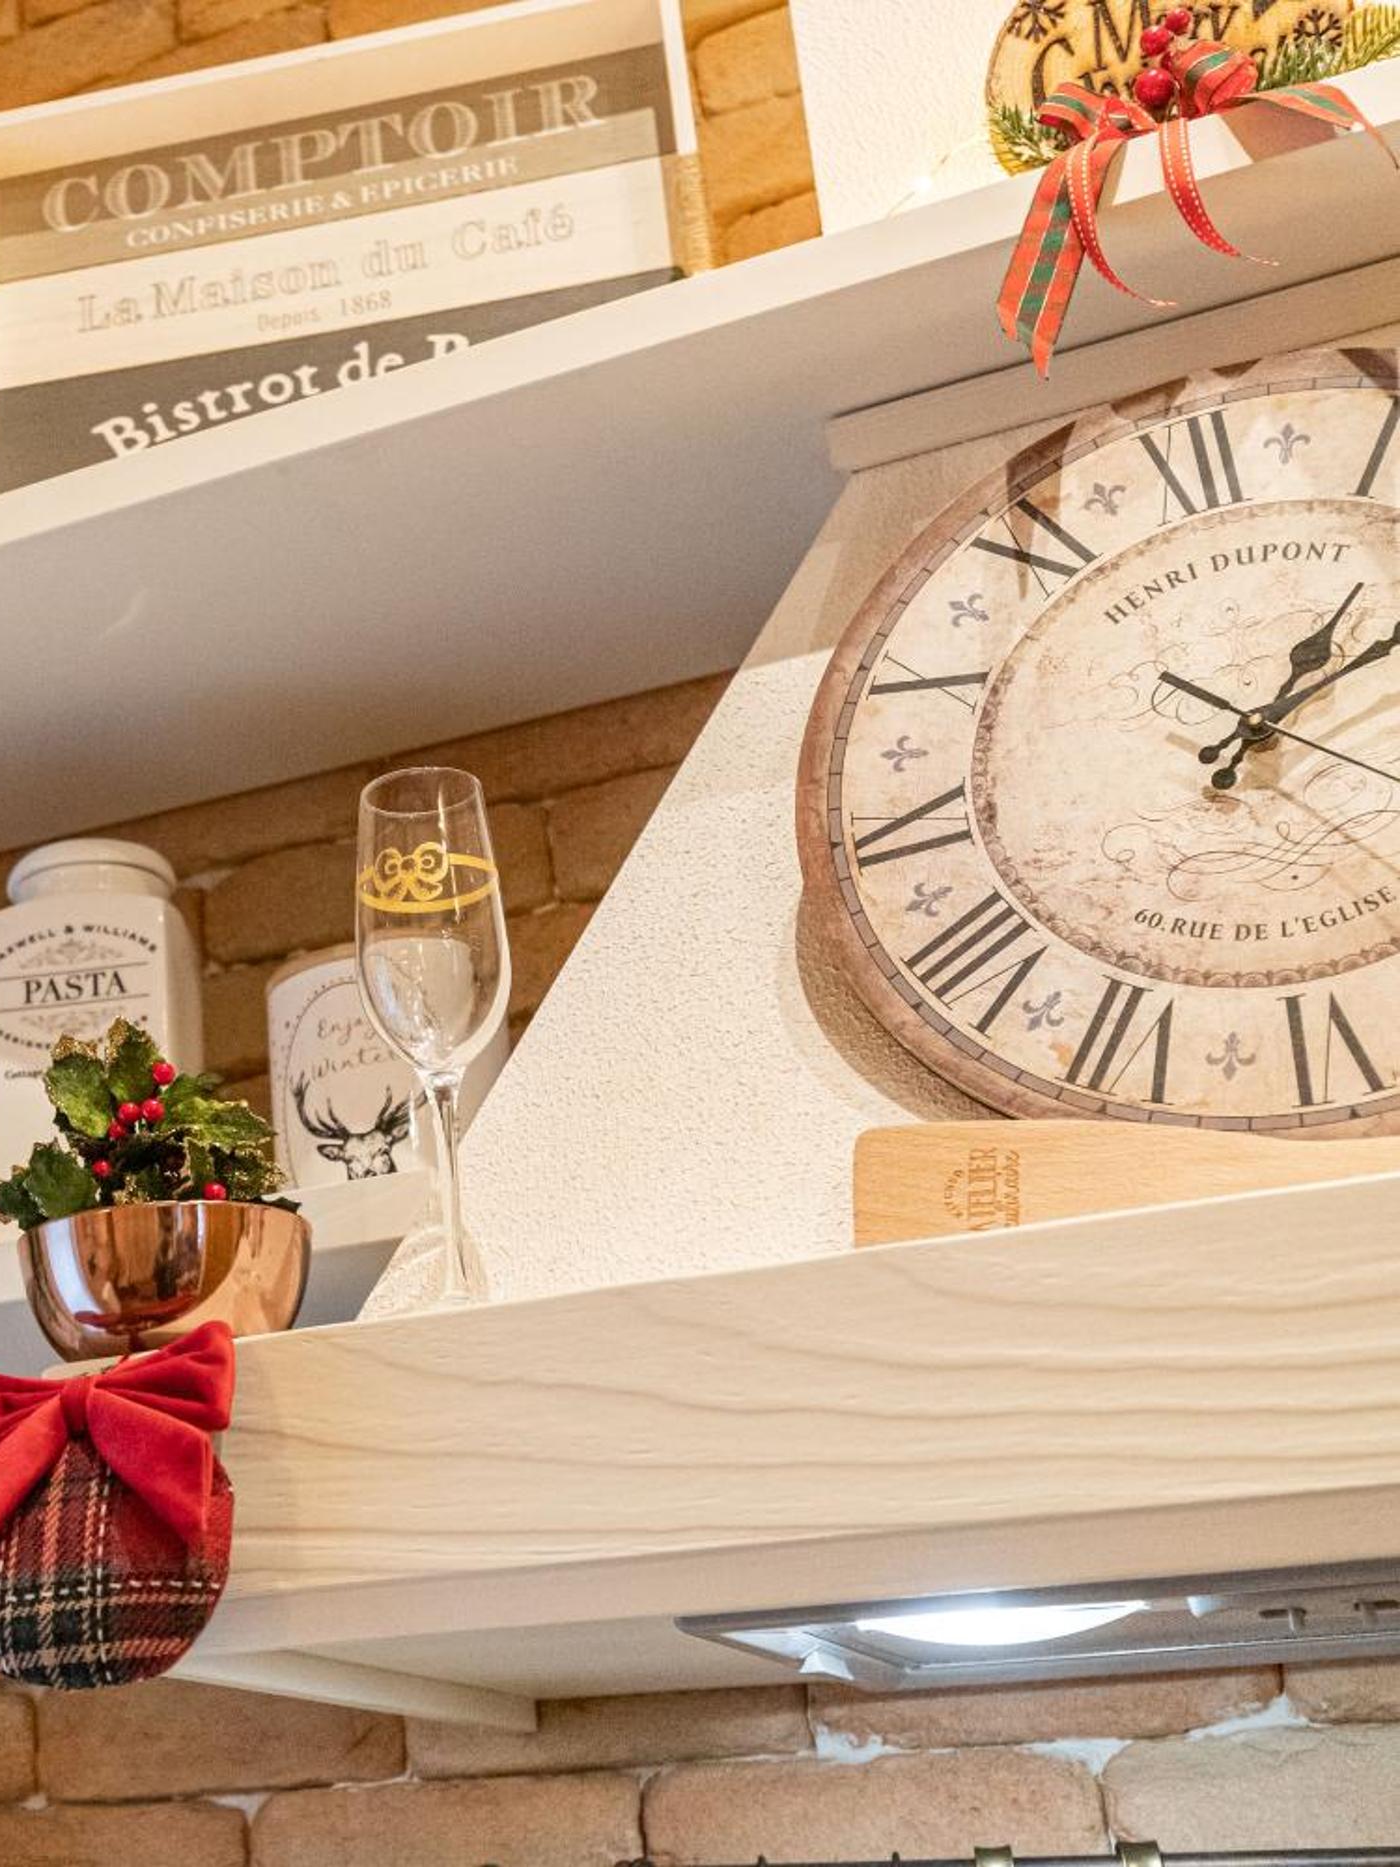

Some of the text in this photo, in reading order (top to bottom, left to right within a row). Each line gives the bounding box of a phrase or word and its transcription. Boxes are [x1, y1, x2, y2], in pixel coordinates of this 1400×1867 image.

[43, 74, 606, 233] COMPTOIR
[125, 155, 520, 249] CONFISERIE & EPICERIE
[149, 255, 342, 320] Maison
[361, 238, 429, 282] du
[451, 204, 576, 261] Café
[339, 288, 393, 317] 1868
[91, 363, 322, 459] Bistrot
[1131, 408, 1253, 527] XII
[1103, 541, 1350, 625] HENRI DUPONT
[82, 924, 157, 952] WILLIAMS
[1234, 923, 1269, 942] DE
[1281, 885, 1397, 938] L'EGLISE
[24, 970, 127, 1004] PASTA
